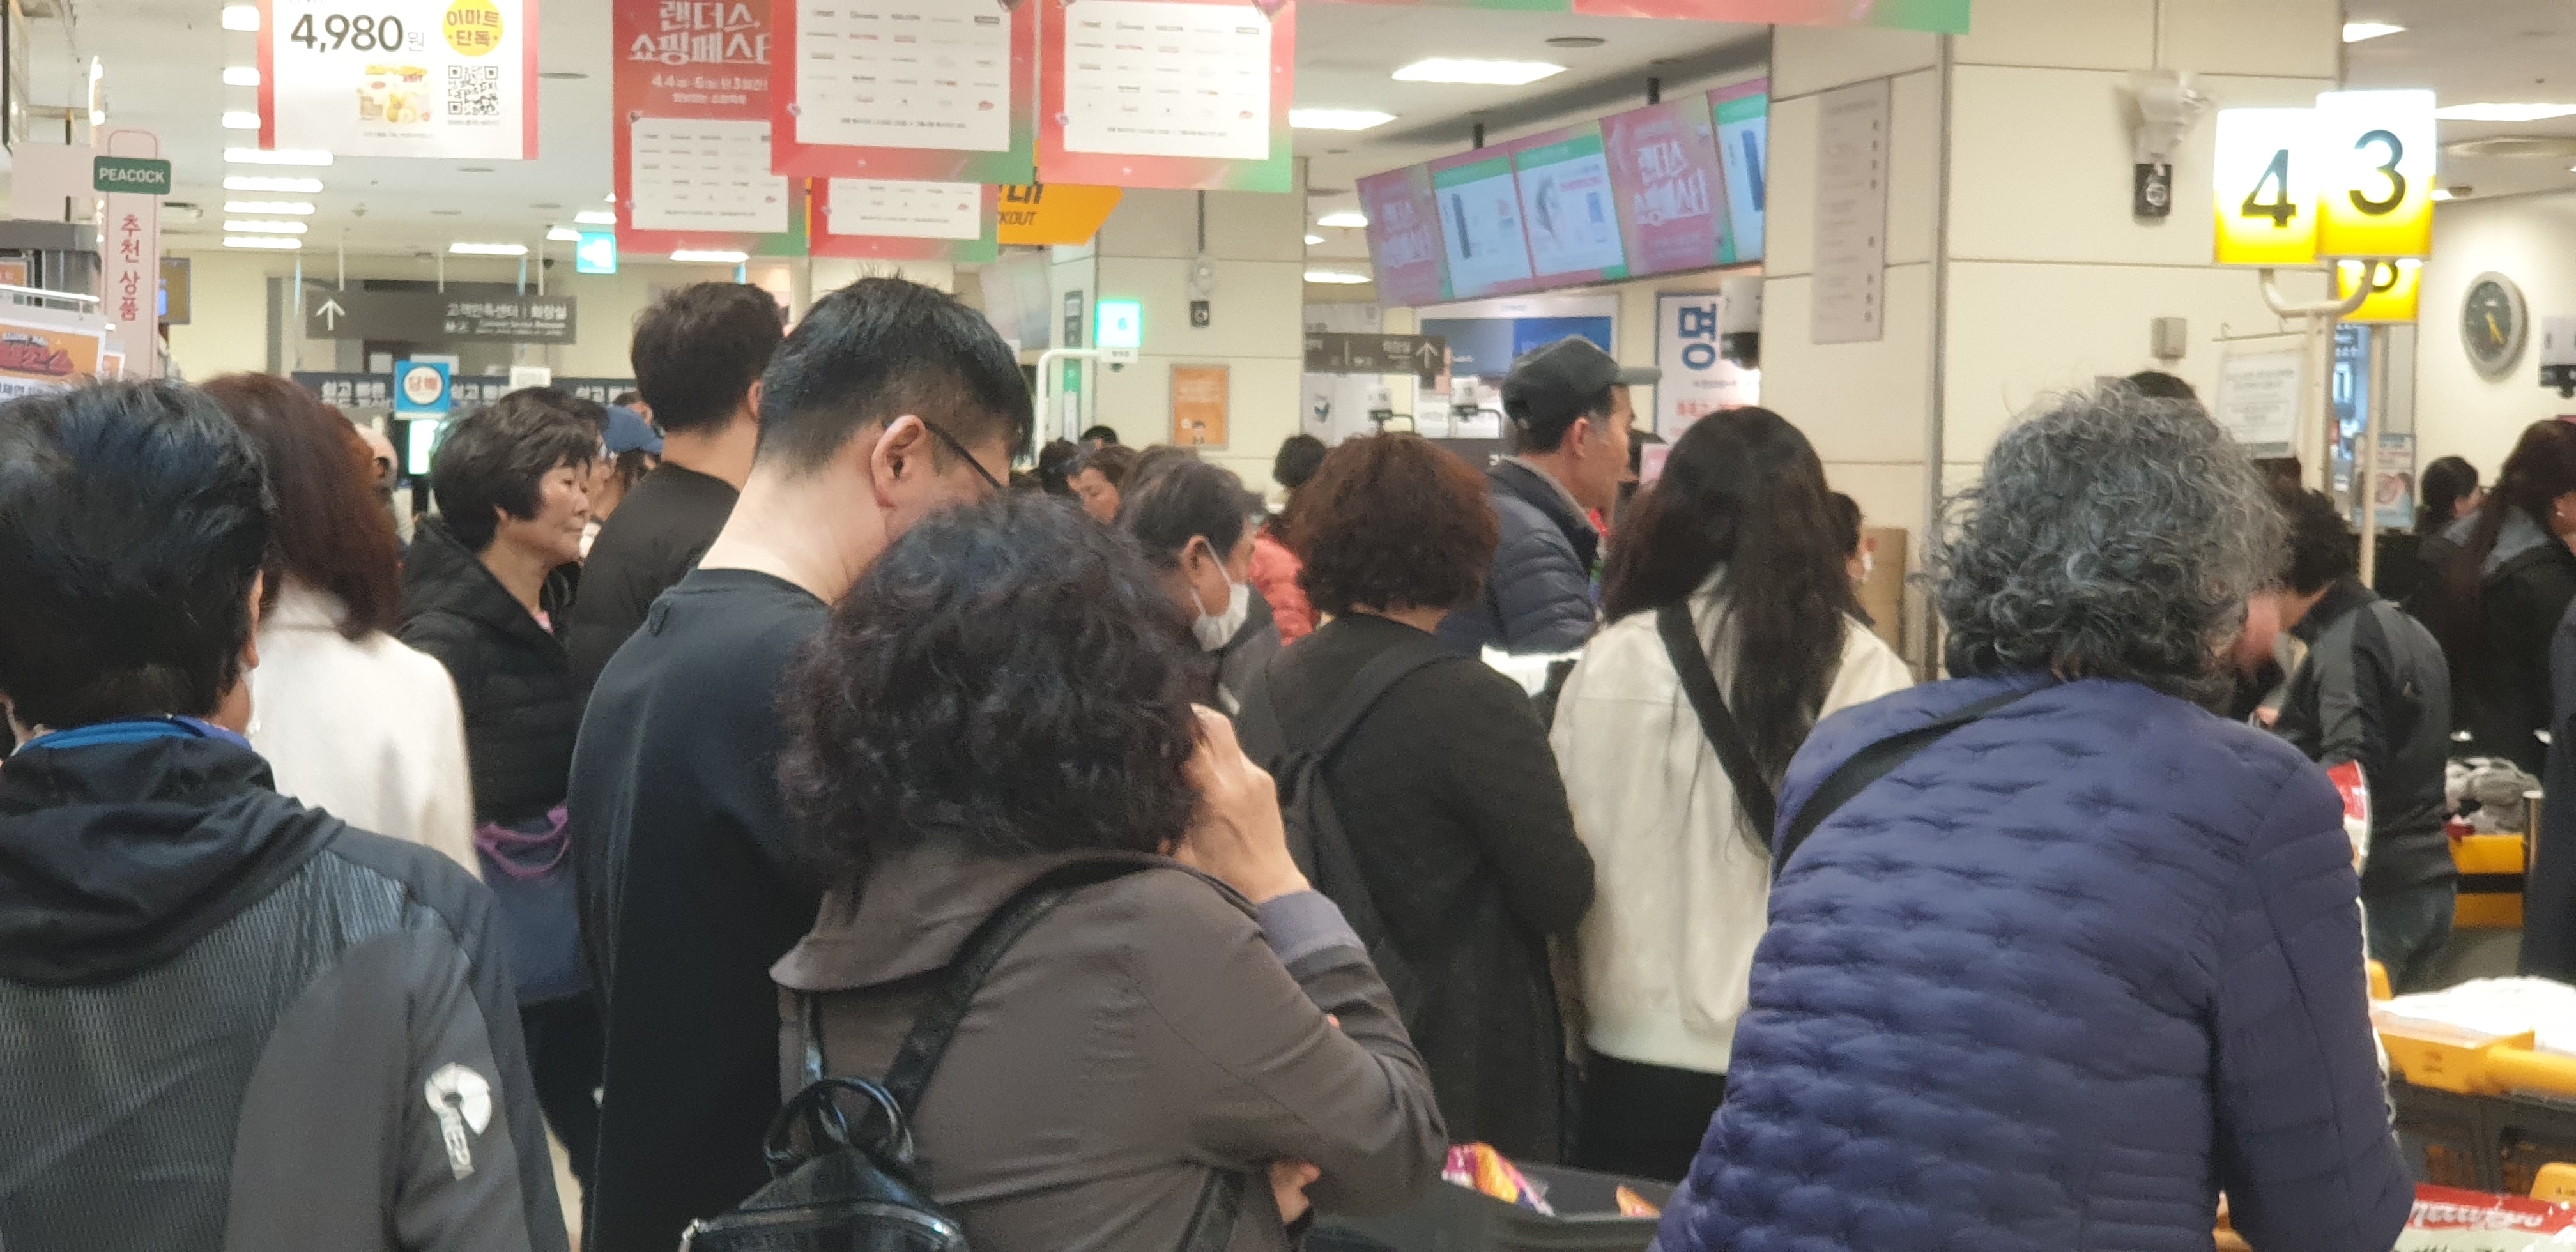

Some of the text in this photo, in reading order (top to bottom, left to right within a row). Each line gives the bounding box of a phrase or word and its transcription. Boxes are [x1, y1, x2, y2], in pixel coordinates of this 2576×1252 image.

[447, 10, 499, 28] 이마트
[456, 30, 490, 46] 단독
[99, 167, 164, 183] PEACOCK
[2241, 149, 2297, 227] 4
[2349, 129, 2407, 216] 3
[999, 211, 1037, 225] KOUT
[119, 214, 141, 321] 추천 상품
[1678, 303, 1717, 370] 명
